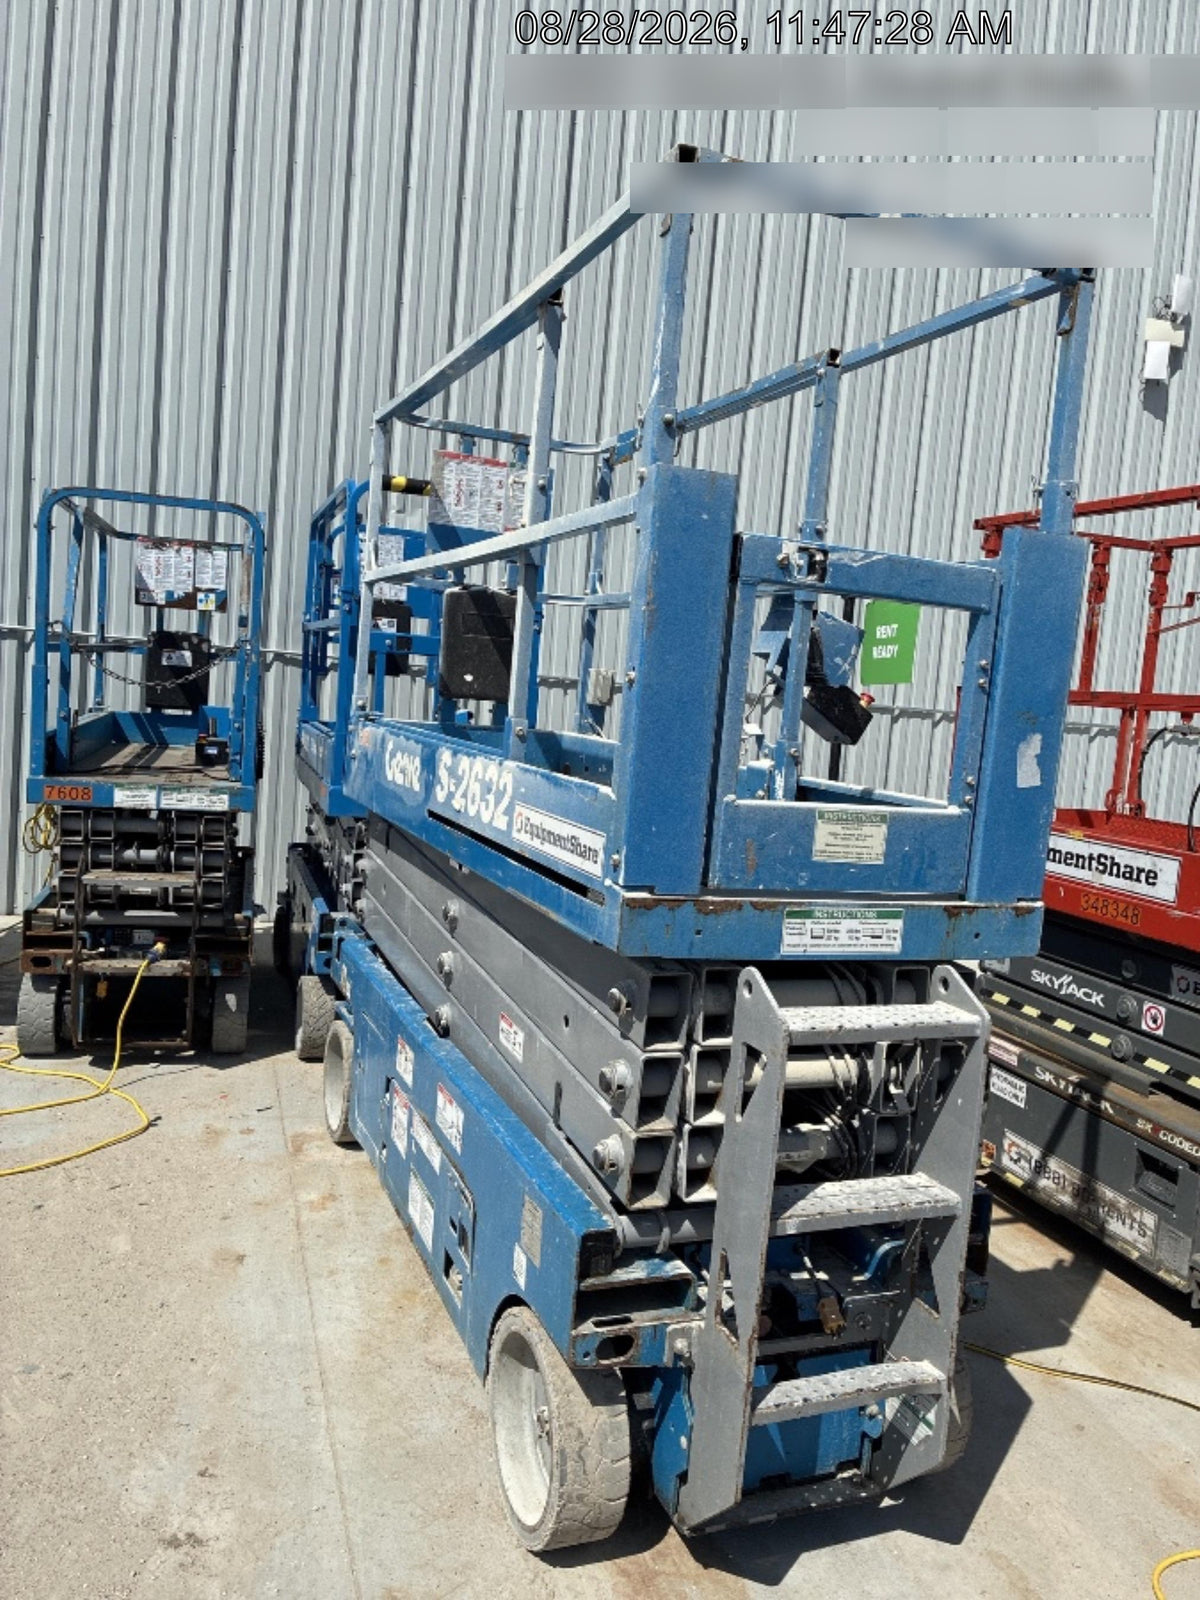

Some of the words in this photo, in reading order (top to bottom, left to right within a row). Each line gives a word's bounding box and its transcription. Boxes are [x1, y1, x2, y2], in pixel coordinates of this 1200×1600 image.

[876, 624, 898, 639] RENT
[872, 645, 898, 659] READY
[45, 785, 92, 800] 7608
[434, 746, 514, 832] S-2632
[523, 817, 599, 866] EquipmentShare
[1081, 893, 1140, 925] 348348
[1030, 969, 1105, 1008] SKYJACK
